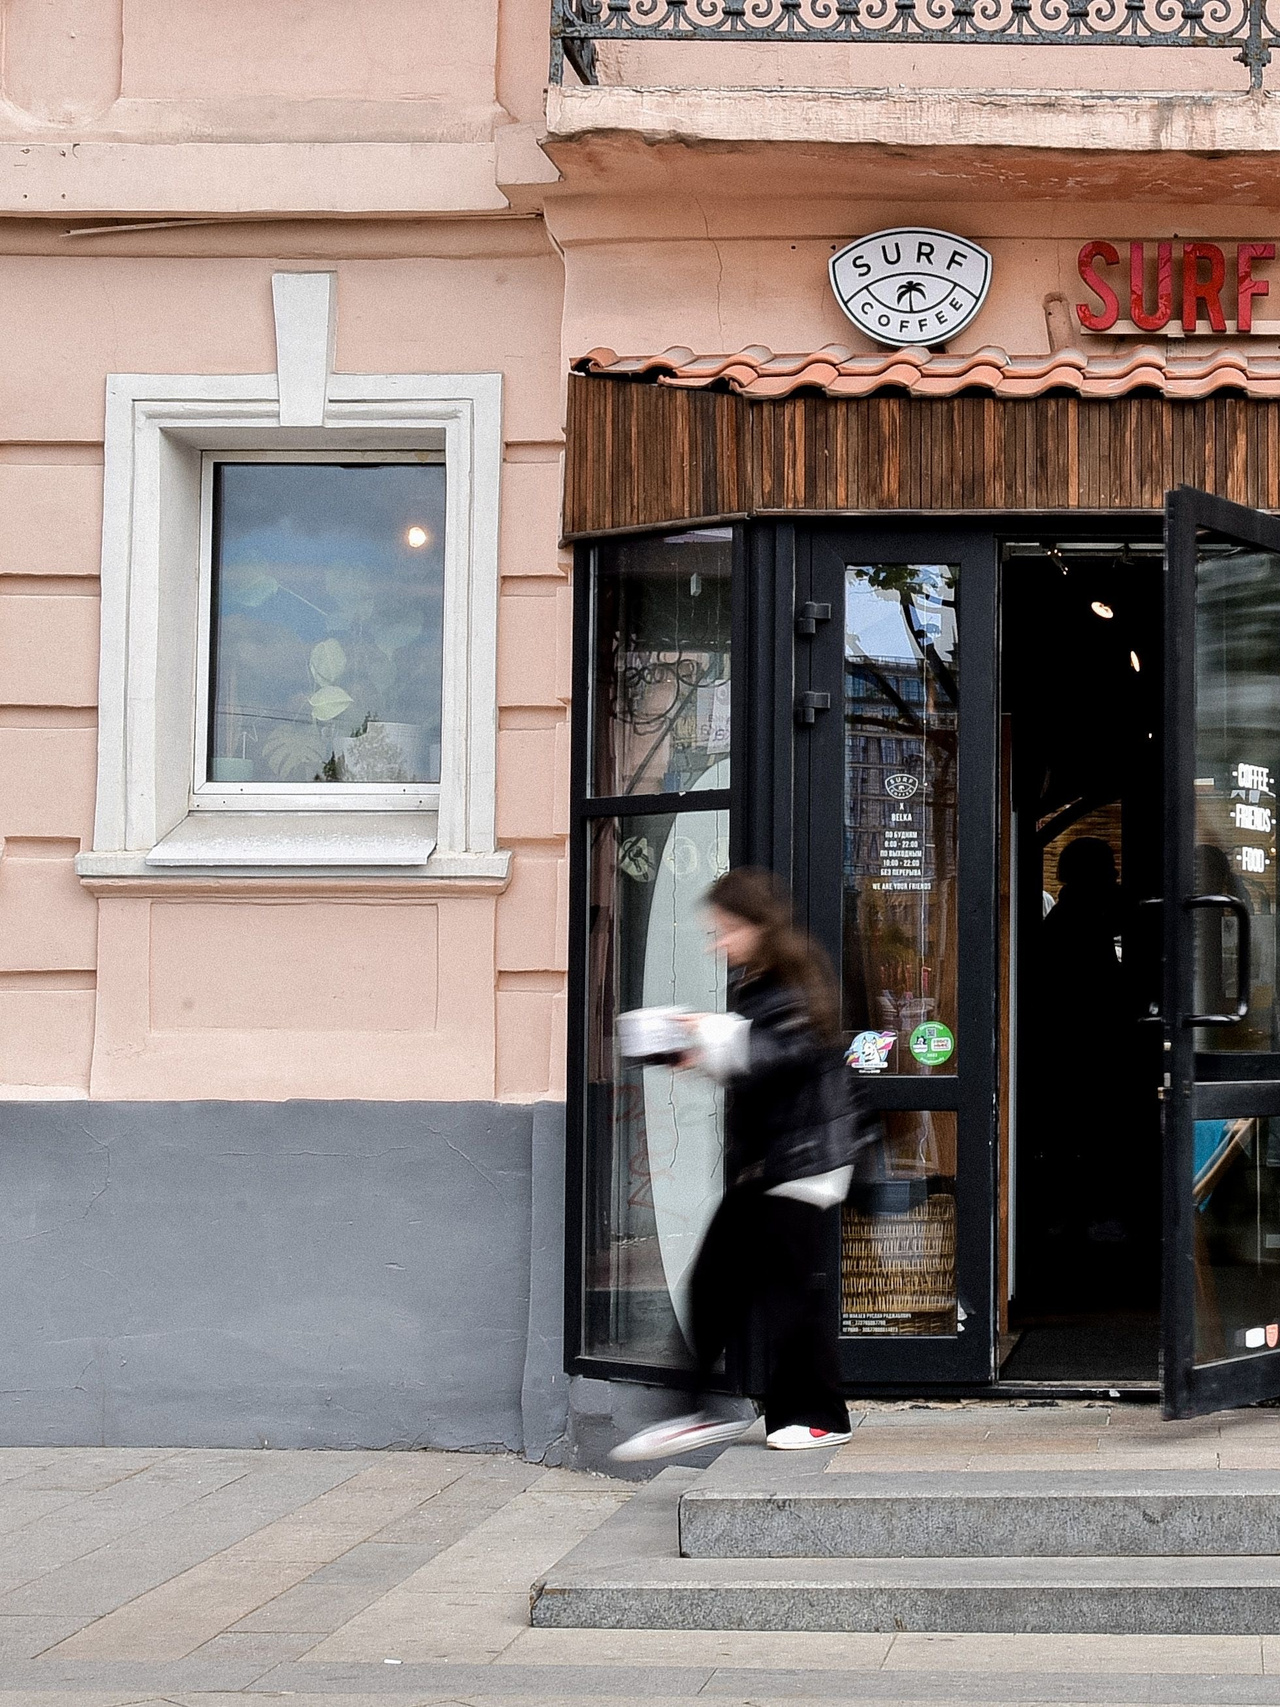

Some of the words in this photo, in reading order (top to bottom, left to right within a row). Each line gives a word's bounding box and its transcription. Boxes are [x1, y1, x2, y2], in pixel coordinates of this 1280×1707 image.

[852, 242, 968, 277] SURF
[1076, 240, 1276, 333] SURF
[861, 297, 964, 333] COFFEE
[890, 776, 914, 785] SURF
[1238, 763, 1269, 793] COFFEE
[891, 813, 913, 822] BELKA
[1235, 803, 1272, 833] FRIENDS
[1241, 846, 1265, 874] FOOD
